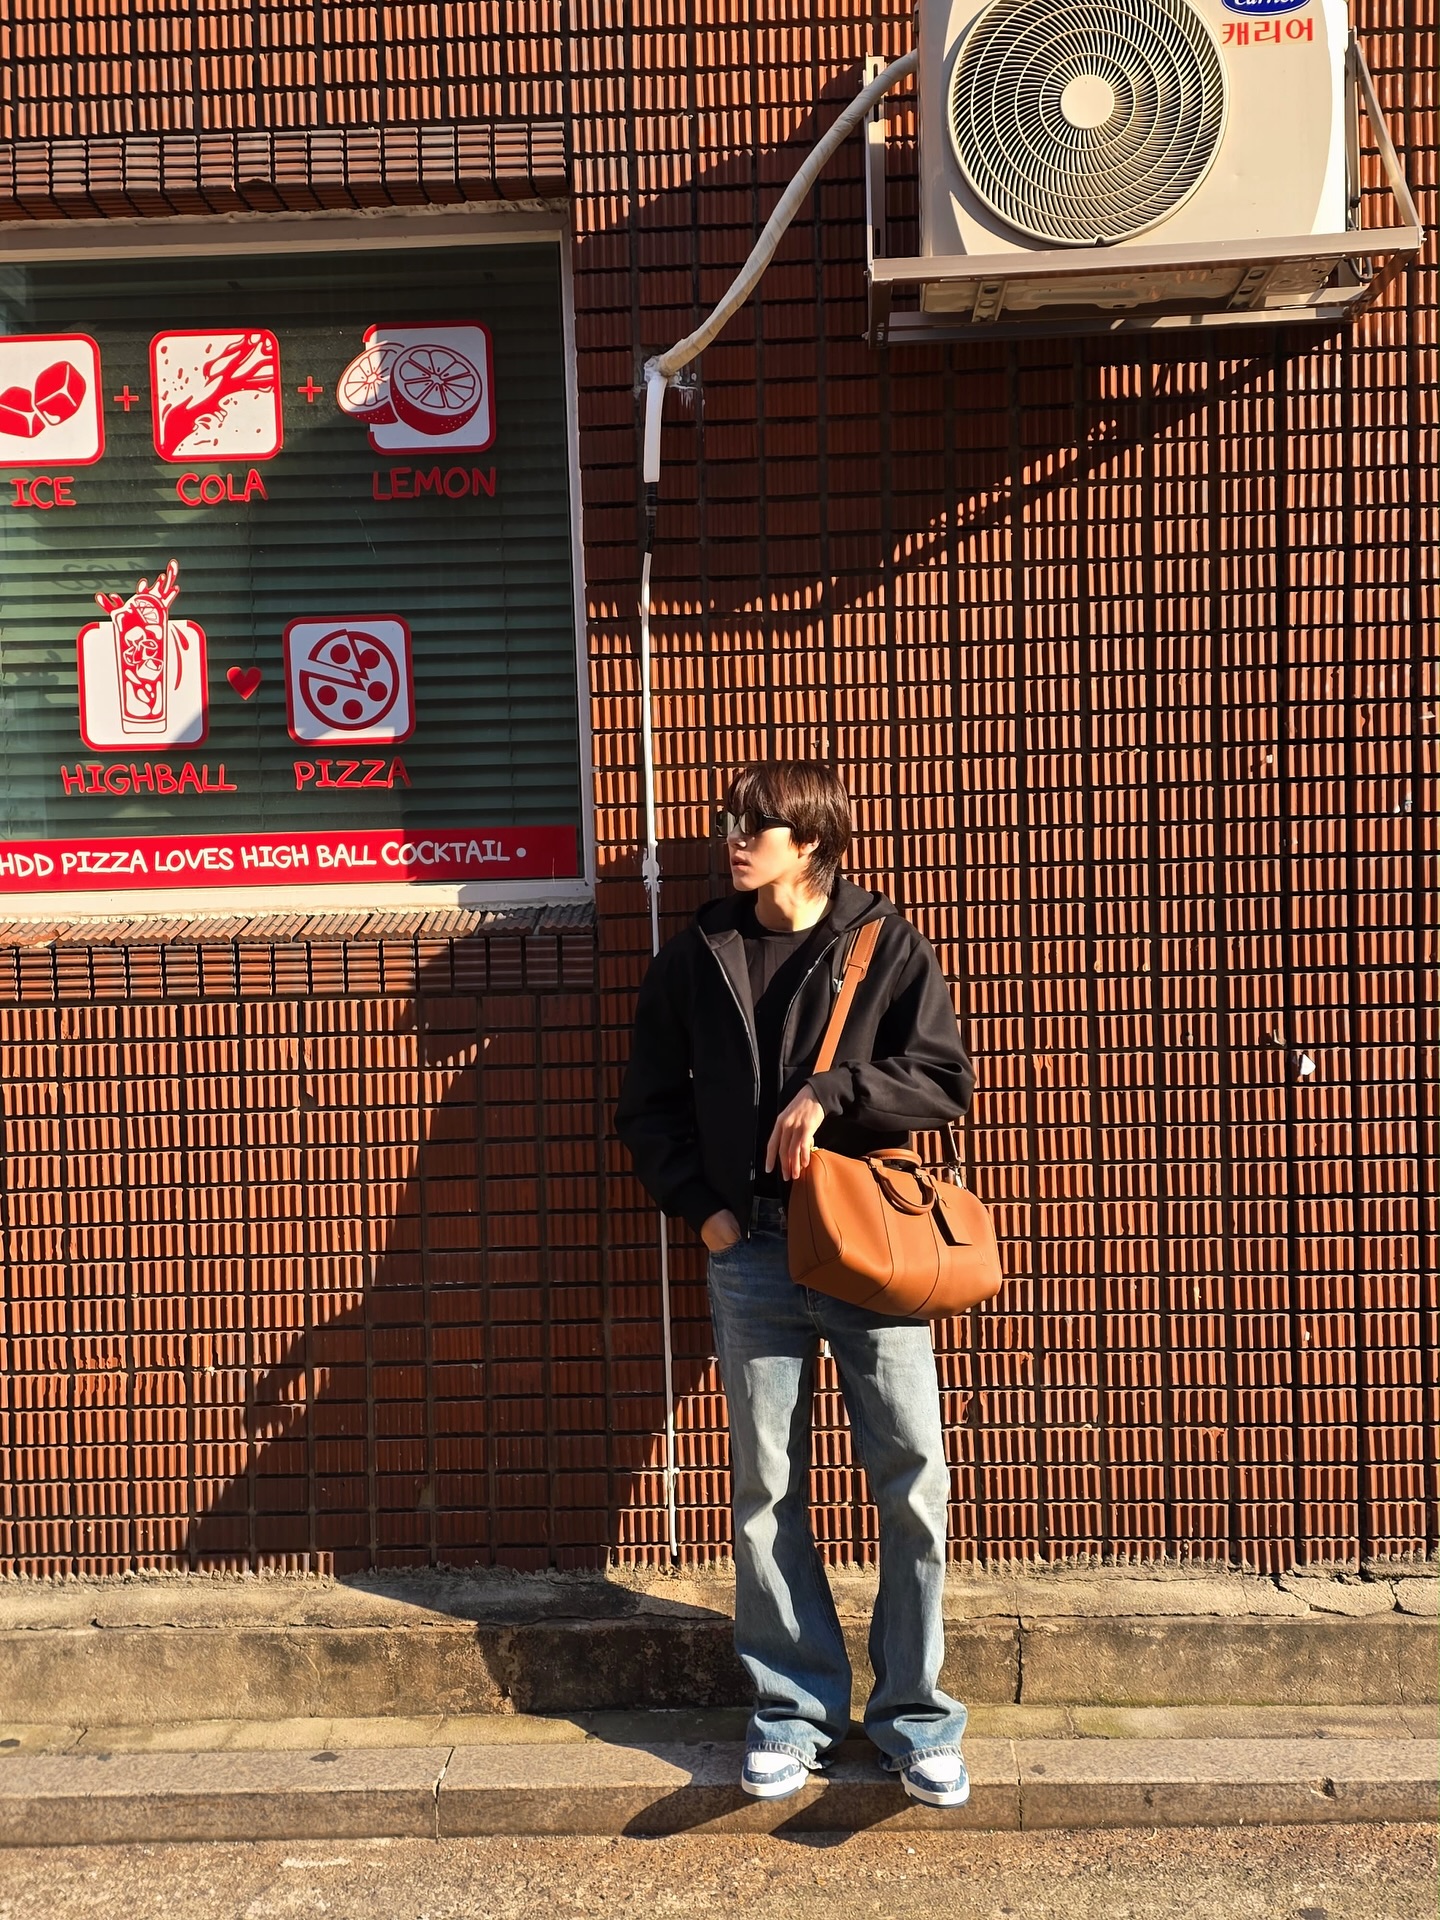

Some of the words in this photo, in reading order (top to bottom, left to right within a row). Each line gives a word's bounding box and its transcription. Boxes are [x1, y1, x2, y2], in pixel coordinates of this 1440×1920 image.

[1222, 18, 1313, 45] 캐리어
[10, 476, 76, 509] ICE
[176, 469, 269, 506] COLA
[372, 466, 496, 500] LEMON
[60, 761, 237, 795] HIGHBALL
[293, 756, 412, 790] PIZZA
[0, 852, 54, 877] HDD
[61, 849, 148, 875] PIZZA
[155, 847, 234, 872] LOVES
[241, 844, 309, 869] HIGH
[317, 843, 377, 868] BALL
[381, 839, 510, 865] COCKTAIL
